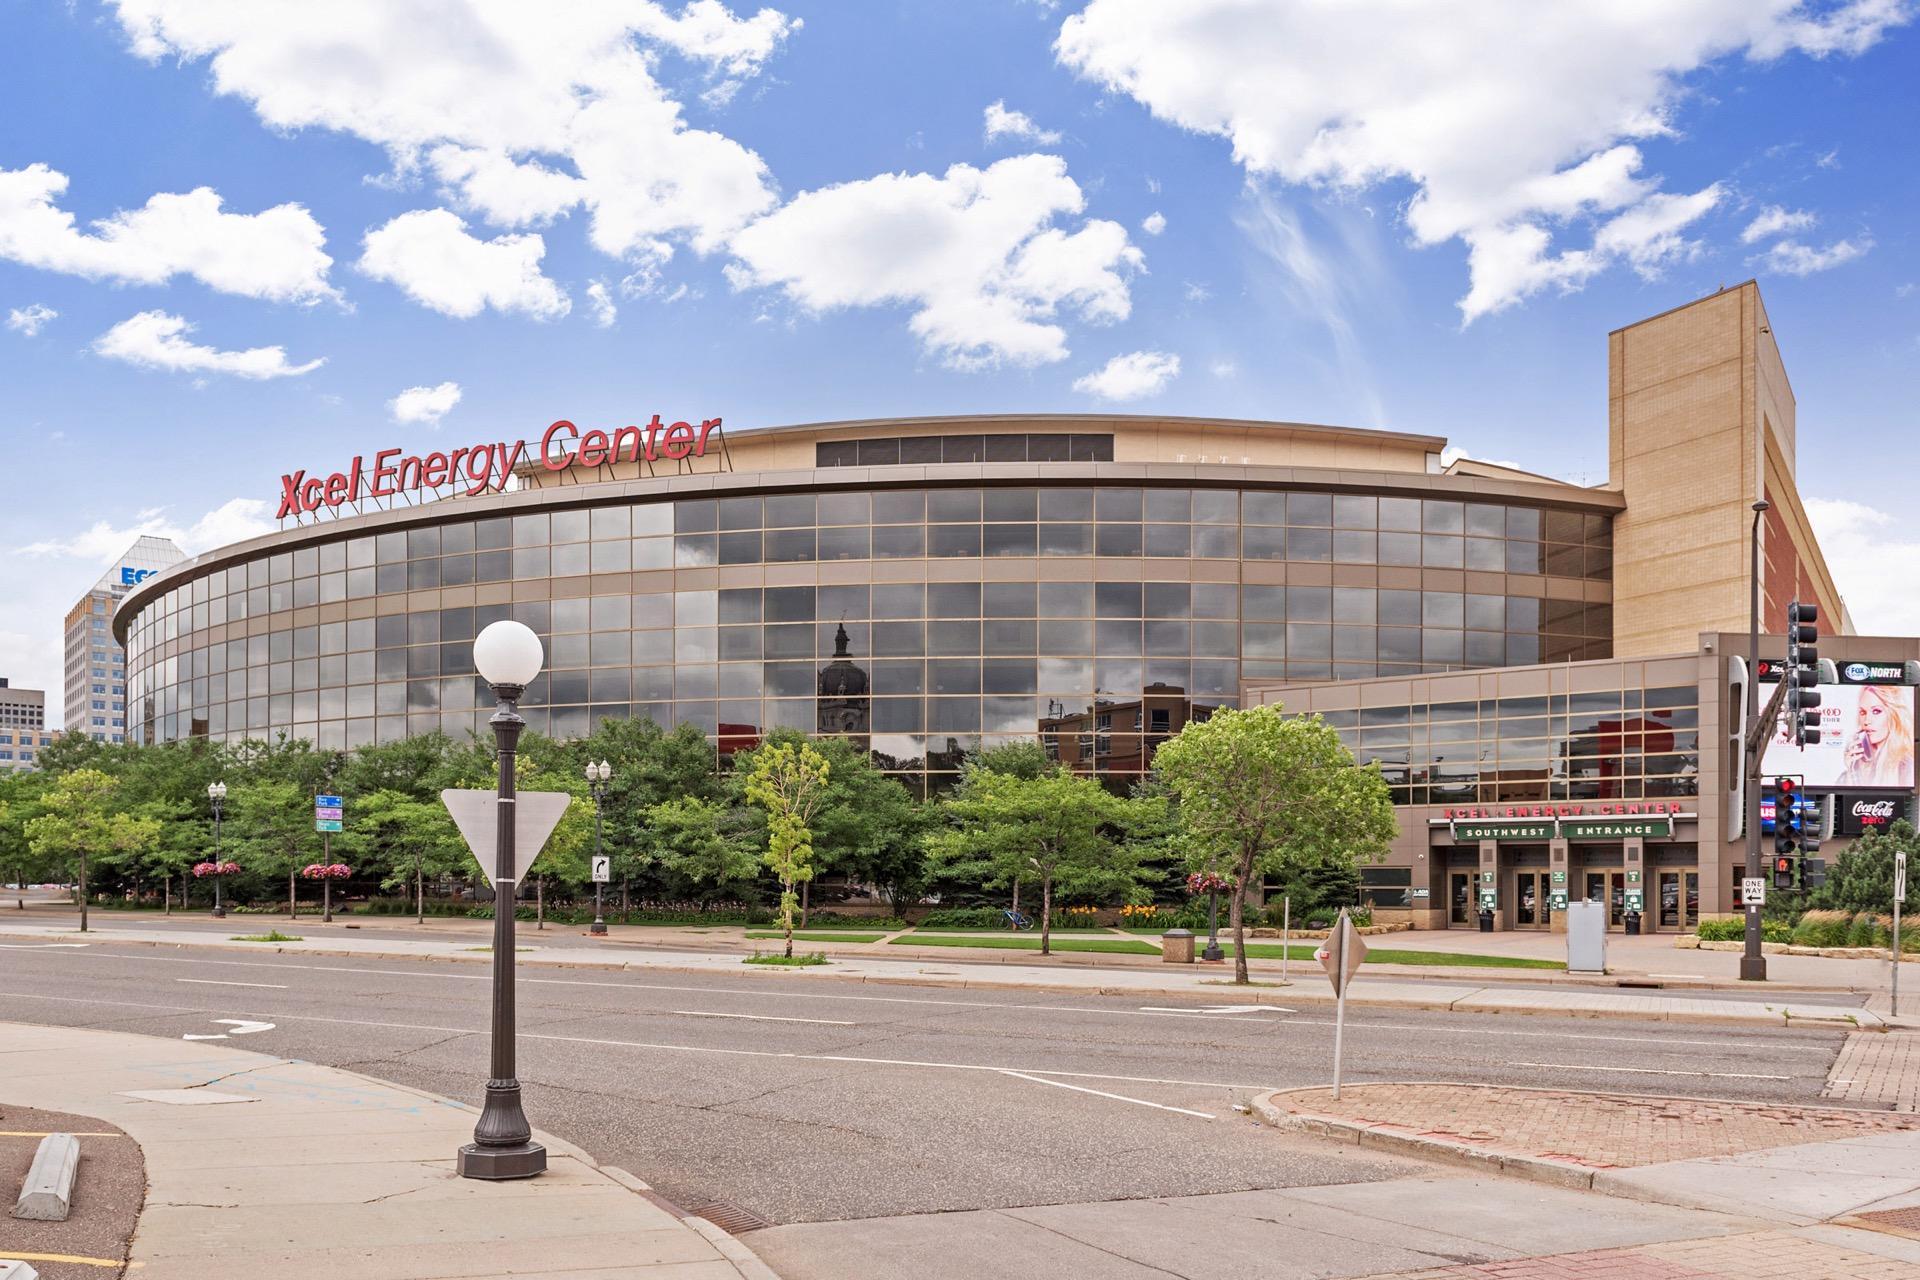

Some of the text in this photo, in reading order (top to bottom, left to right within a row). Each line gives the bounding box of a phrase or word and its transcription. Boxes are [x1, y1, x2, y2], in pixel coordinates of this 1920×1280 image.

[276, 414, 722, 519] Xcel Energy Center
[1870, 667, 1902, 678] NORTH
[1443, 800, 1681, 819] XCEL ENERGY CENTER
[1861, 816, 1885, 824] zero
[1466, 825, 1652, 837] SOUTHWEST ENTRANCE
